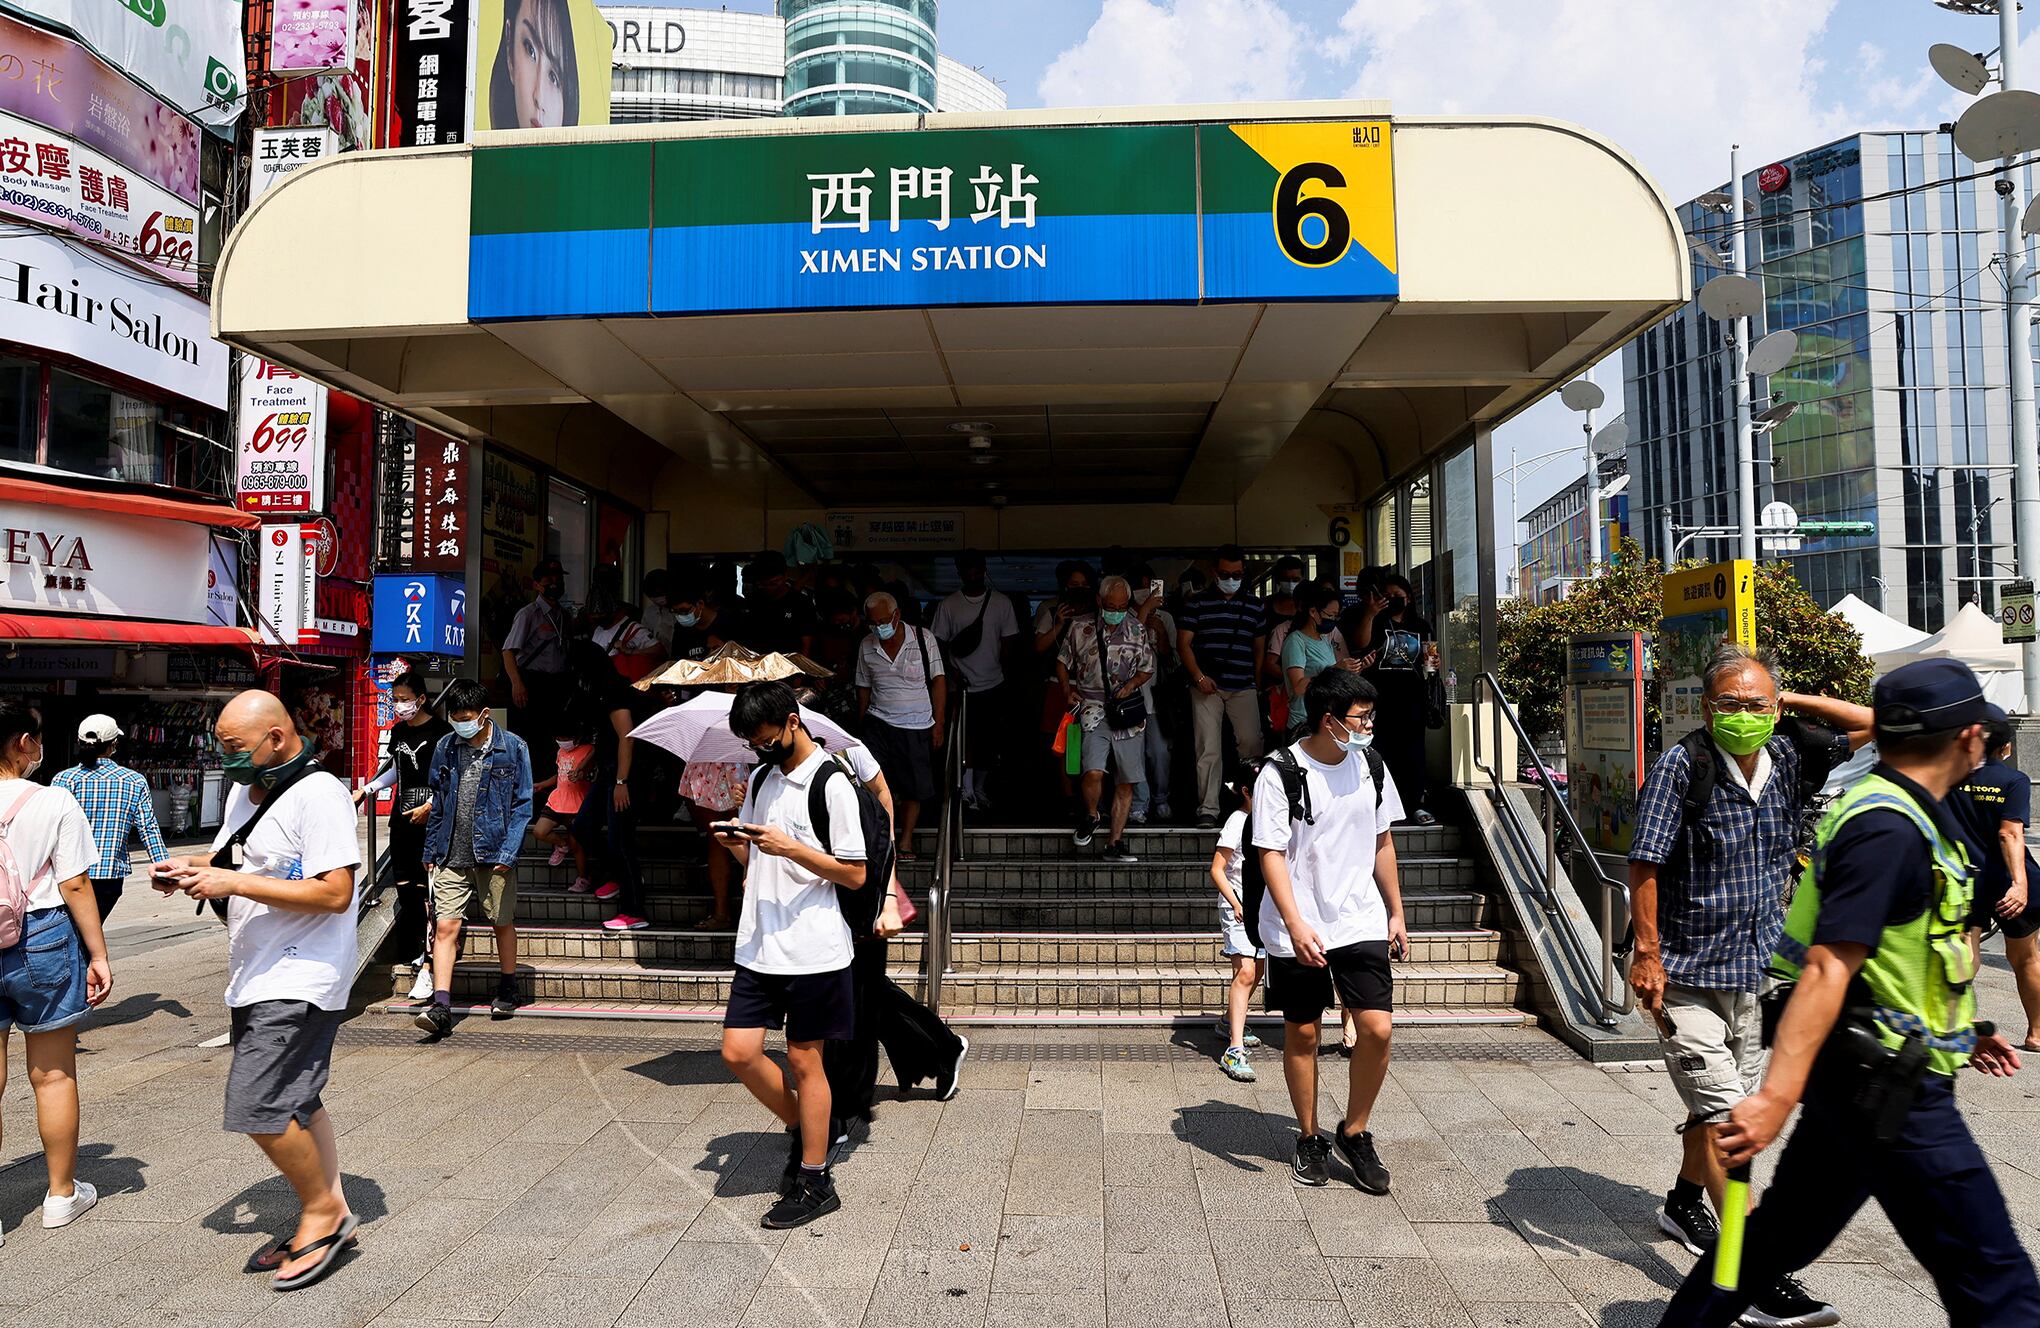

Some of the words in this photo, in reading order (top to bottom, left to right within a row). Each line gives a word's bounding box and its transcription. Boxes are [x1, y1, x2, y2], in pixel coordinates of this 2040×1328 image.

[281, 21, 340, 31] 02-2331-5793
[415, 54, 440, 146] 網路電競
[446, 131, 458, 143] 西
[1352, 126, 1381, 143] 出入口
[260, 136, 322, 159] 玉芙蓉
[2, 175, 28, 188] Body
[31, 179, 71, 194] Massage
[78, 165, 130, 213] 護膚
[807, 163, 1040, 235] 西門站
[80, 203, 97, 214] Face
[98, 206, 129, 220] Treatment
[1276, 162, 1351, 266] 6
[132, 211, 194, 271] $699
[800, 248, 901, 274] XIMEN
[911, 244, 1047, 271] STATION
[0, 258, 103, 325] Hair
[110, 297, 201, 367] Salon
[266, 386, 293, 395] Face
[250, 397, 307, 407] Treatment
[277, 412, 312, 426] 體驗價
[243, 413, 308, 453] $699
[250, 461, 299, 474] 預約專線
[241, 475, 308, 490] 0965-879-000
[261, 494, 304, 507] 請上三樓
[436, 442, 461, 557] 鼎王麻辣鍋
[1329, 516, 1351, 547] 6
[44, 574, 87, 591] 旗艦店
[274, 573, 284, 603] Hair
[22, 656, 56, 671] Hair
[57, 656, 100, 671] Salon
